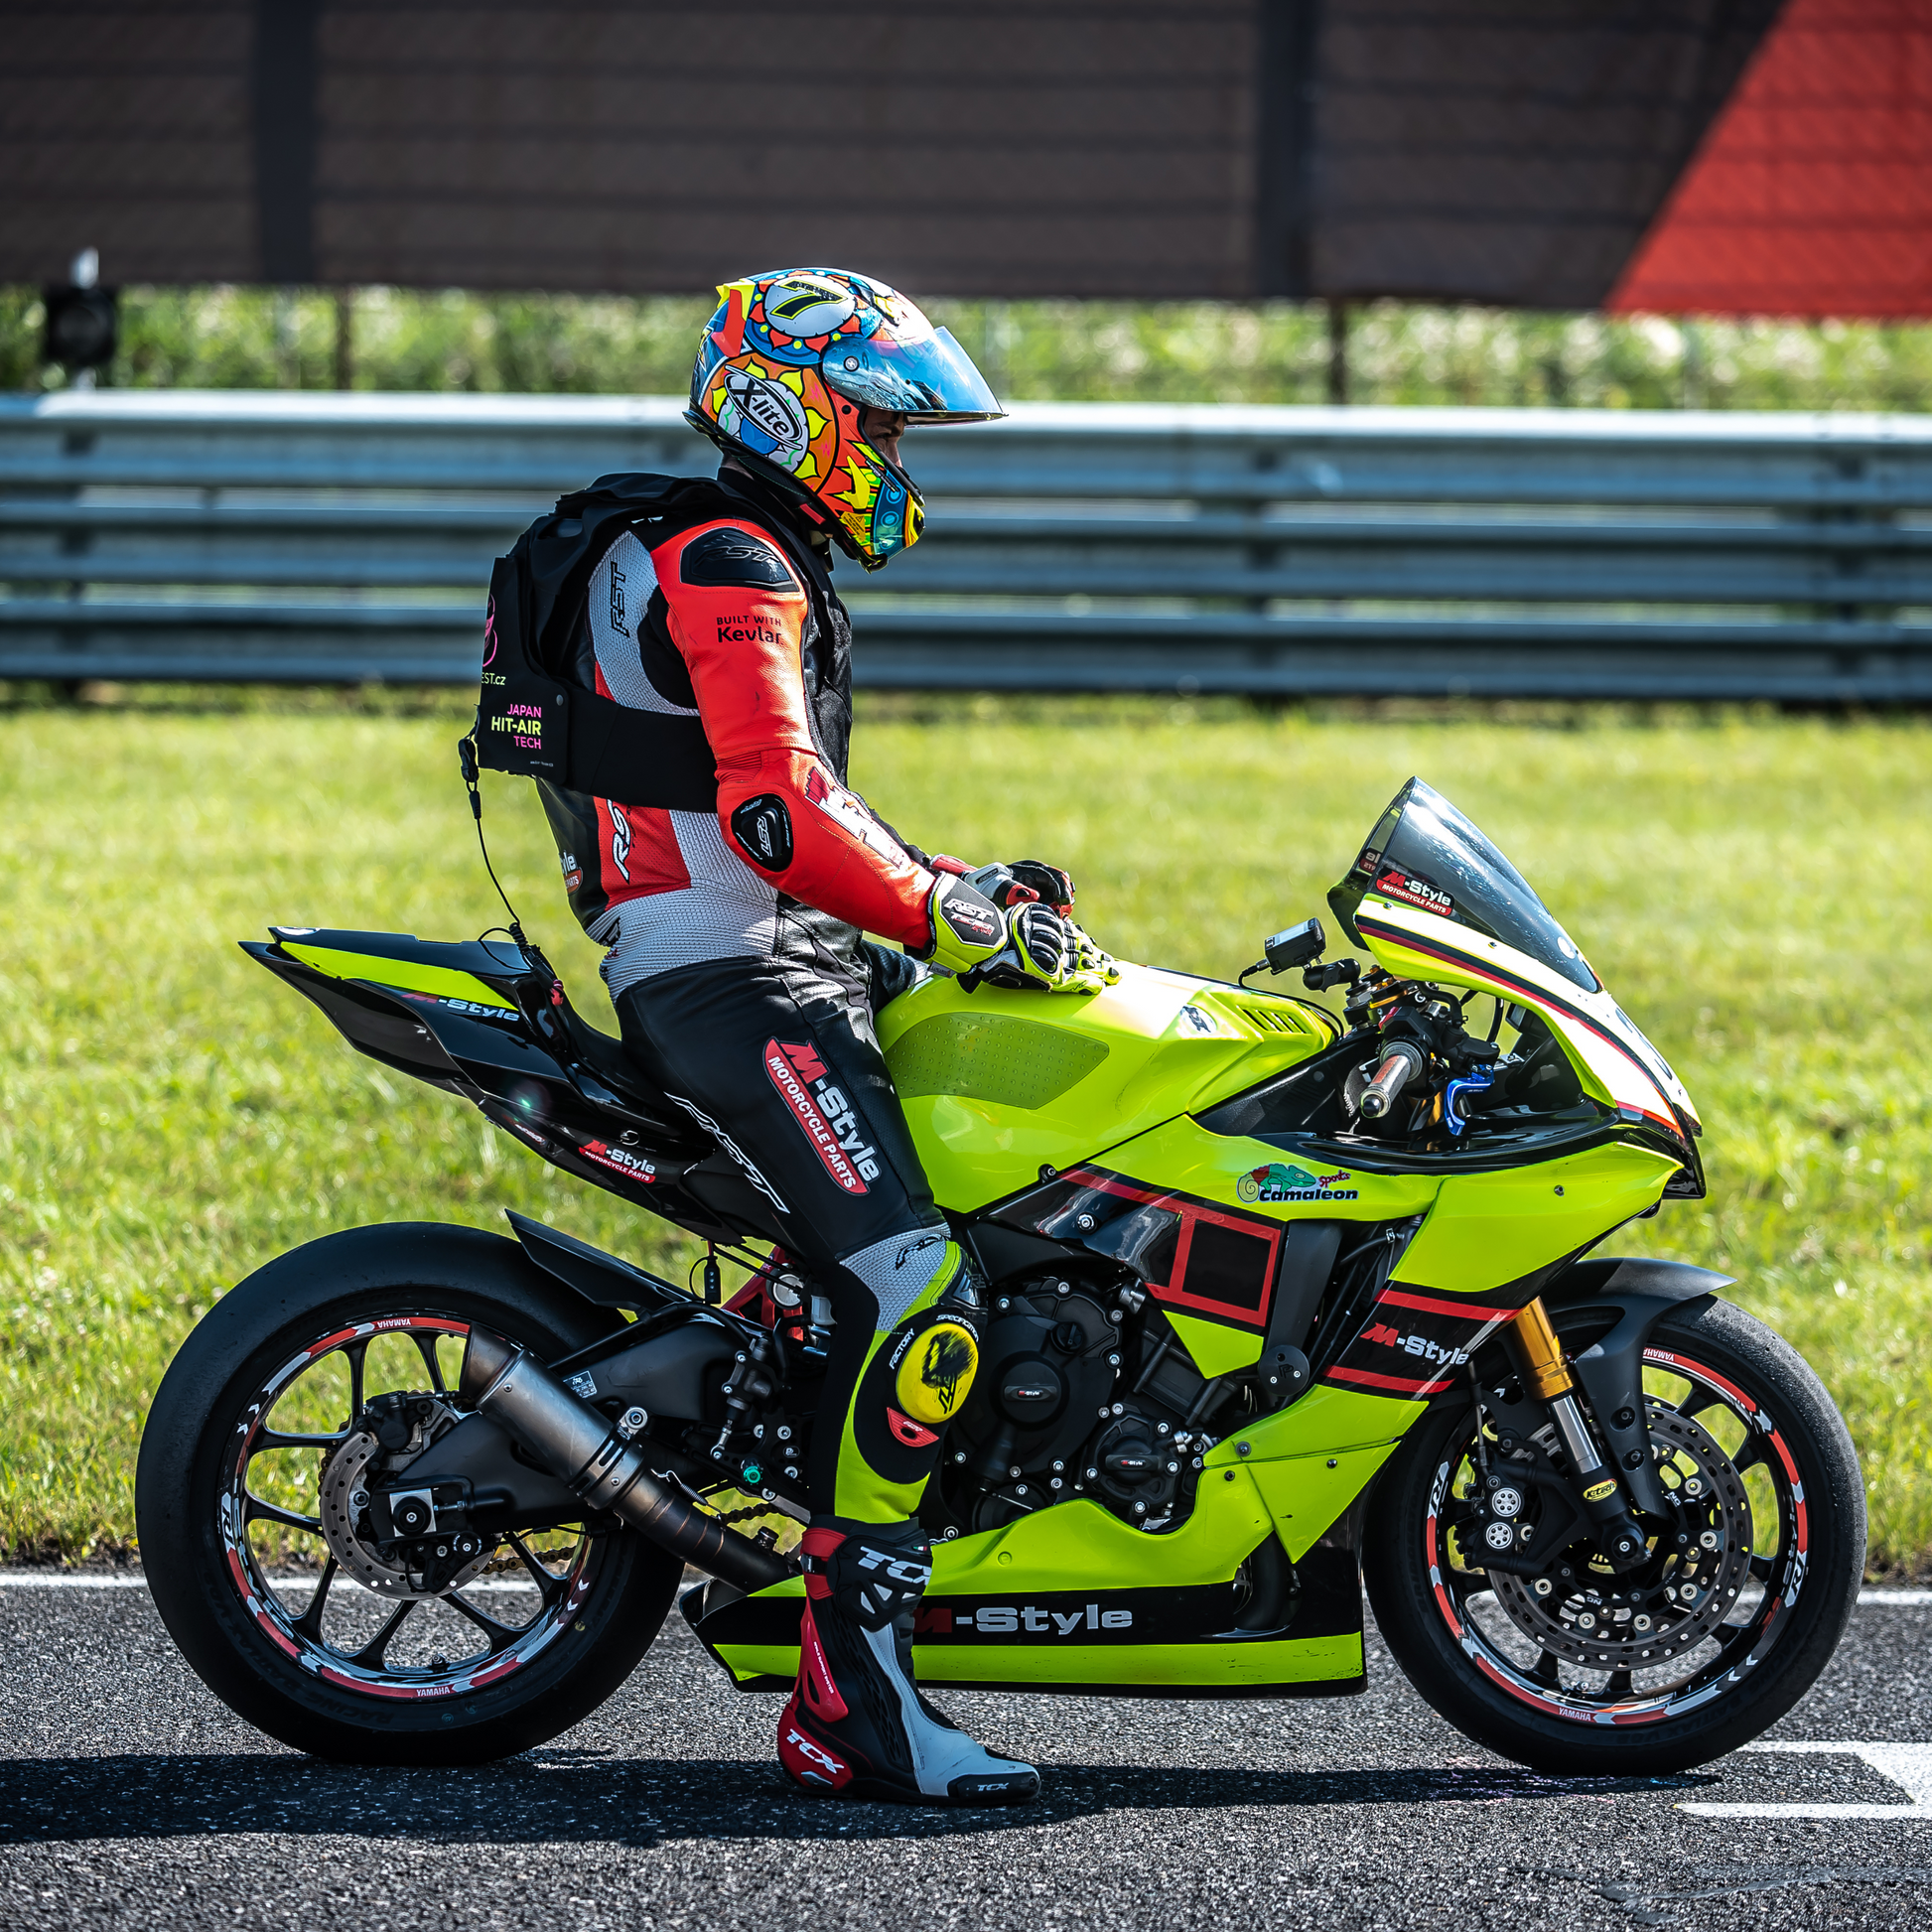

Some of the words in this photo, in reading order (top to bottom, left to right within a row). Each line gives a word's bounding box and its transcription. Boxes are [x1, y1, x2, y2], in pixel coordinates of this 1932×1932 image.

[734, 377, 790, 437] X-lite
[716, 615, 750, 626] BUILT
[753, 615, 782, 627] WITH
[490, 716, 542, 736] HIT-AIR
[506, 703, 542, 718] JAPAN
[512, 735, 542, 750] TECH
[607, 798, 630, 883] RS
[1381, 883, 1426, 905] MOTORCYCLE
[1425, 899, 1448, 914] PARTS
[1382, 870, 1451, 906] M-Style
[943, 897, 994, 921] RST
[400, 990, 520, 1022] M-Style
[767, 1055, 831, 1145] MOTORCYCLE
[823, 1143, 857, 1188] PARTS
[779, 1041, 880, 1181] M-Style
[584, 1138, 656, 1174] M-Style
[584, 1151, 627, 1173] MOTORCYCLE
[627, 1169, 651, 1182] PARTS
[1259, 1189, 1359, 1202] Camaleon
[377, 1318, 412, 1328] YAMAHA
[1359, 1321, 1470, 1365] M-Style
[417, 1686, 451, 1697] YAMAHA
[1559, 1707, 1591, 1722] YAMAHA
[786, 1727, 845, 1774] TCX
[977, 1782, 1010, 1792] TCX
